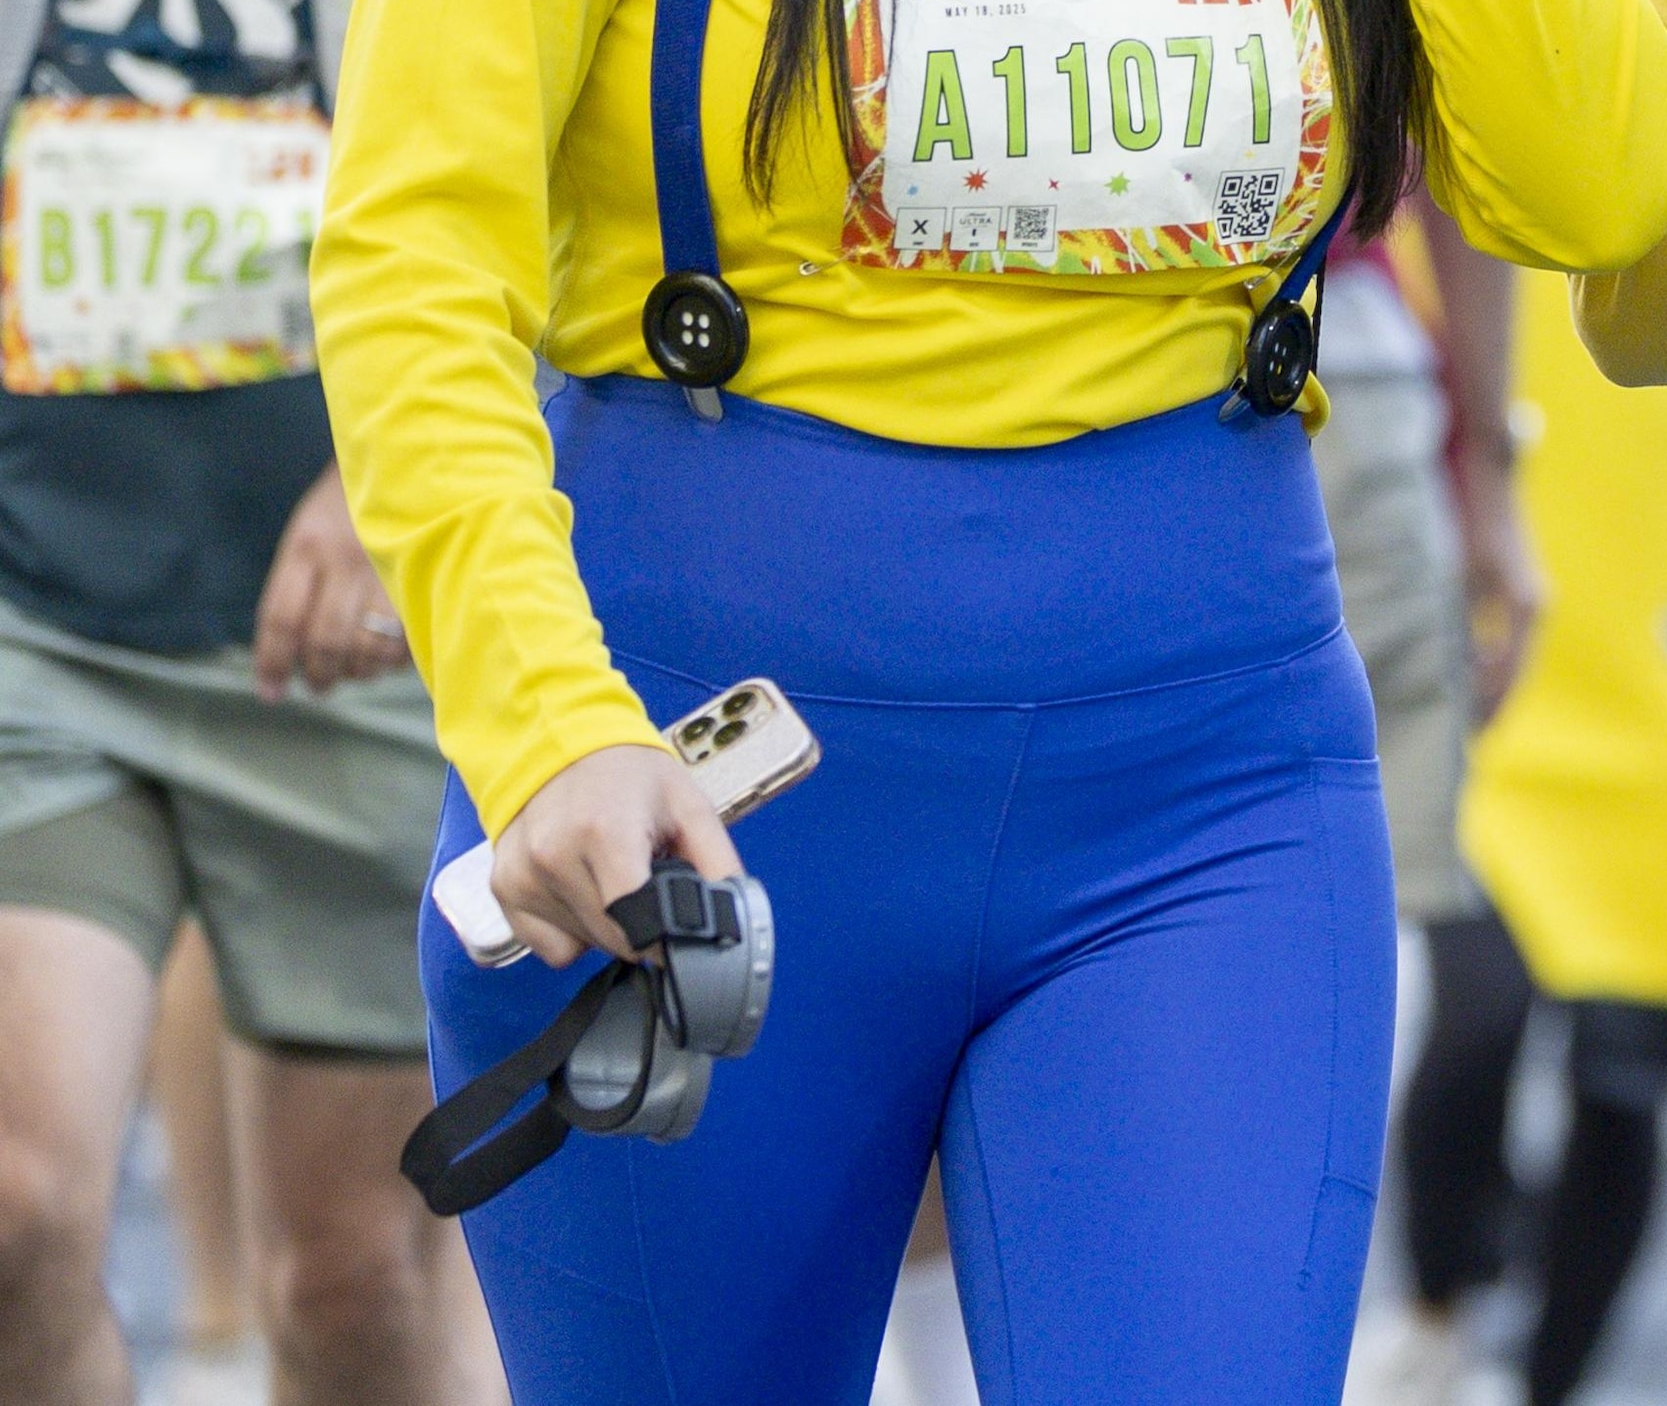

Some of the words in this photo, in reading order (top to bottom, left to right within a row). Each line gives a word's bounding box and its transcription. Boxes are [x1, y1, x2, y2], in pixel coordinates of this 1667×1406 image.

[945, 7, 968, 17] MAY
[999, 3, 1026, 16] 2025
[912, 33, 1272, 162] A11071
[959, 217, 993, 226] ULTRA
